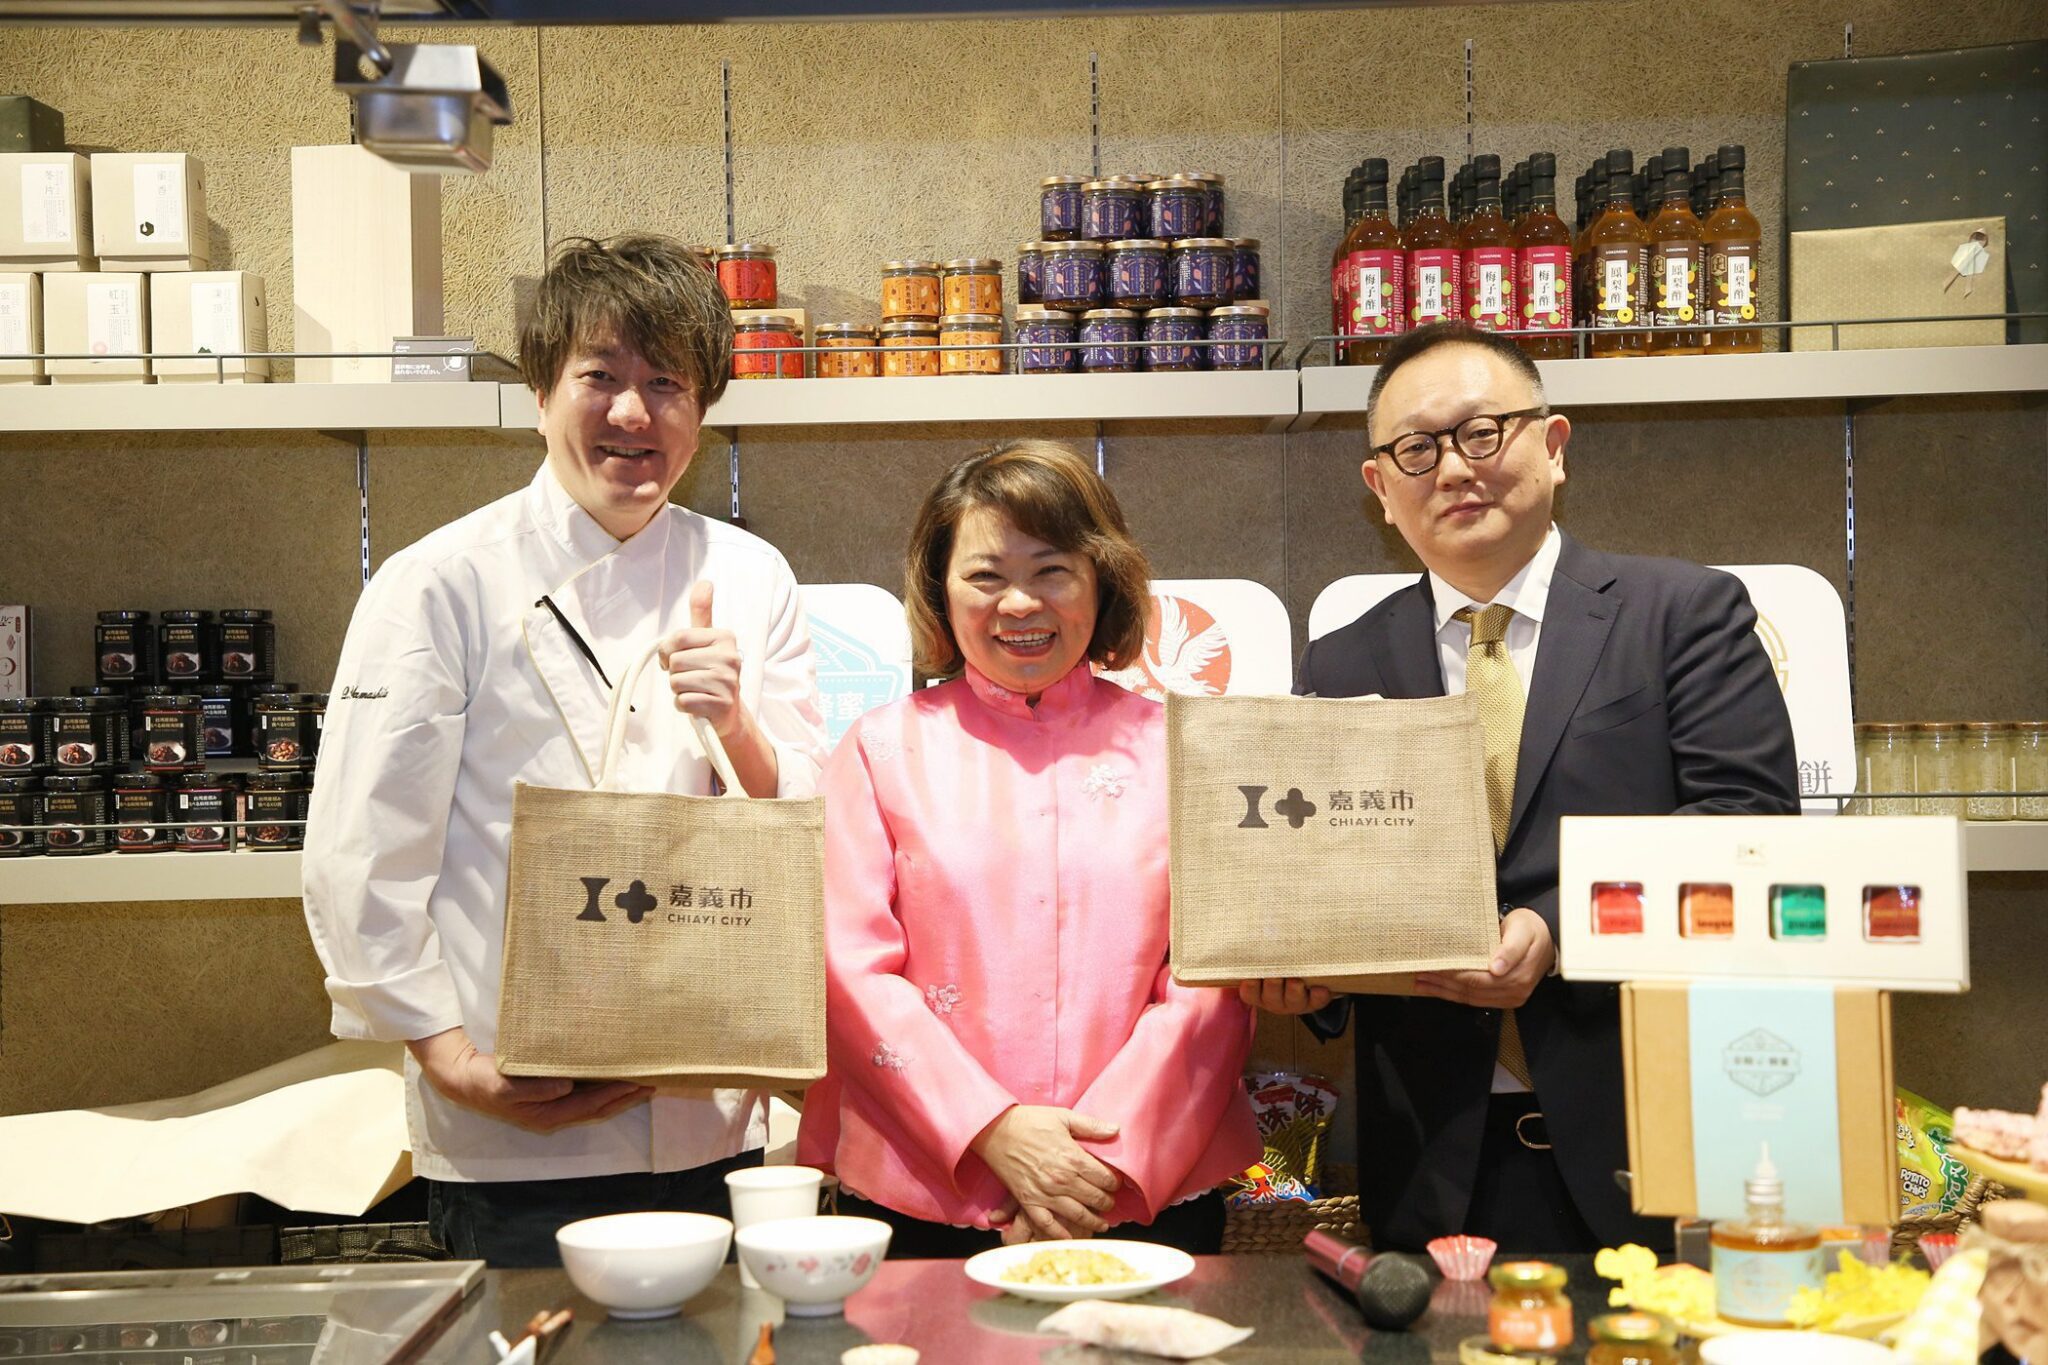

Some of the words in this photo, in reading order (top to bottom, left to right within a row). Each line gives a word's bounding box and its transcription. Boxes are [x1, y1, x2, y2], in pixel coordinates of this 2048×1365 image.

[1329, 790, 1414, 811] 嘉義市
[1329, 817, 1378, 827] CHIAYI
[1384, 817, 1414, 826] CITY
[669, 884, 754, 909] 嘉義市
[667, 913, 716, 924] CHIAYI
[721, 916, 752, 926] CITY
[1901, 1169, 1930, 1187] POTATO
[1904, 1181, 1927, 1199] CHIPS
